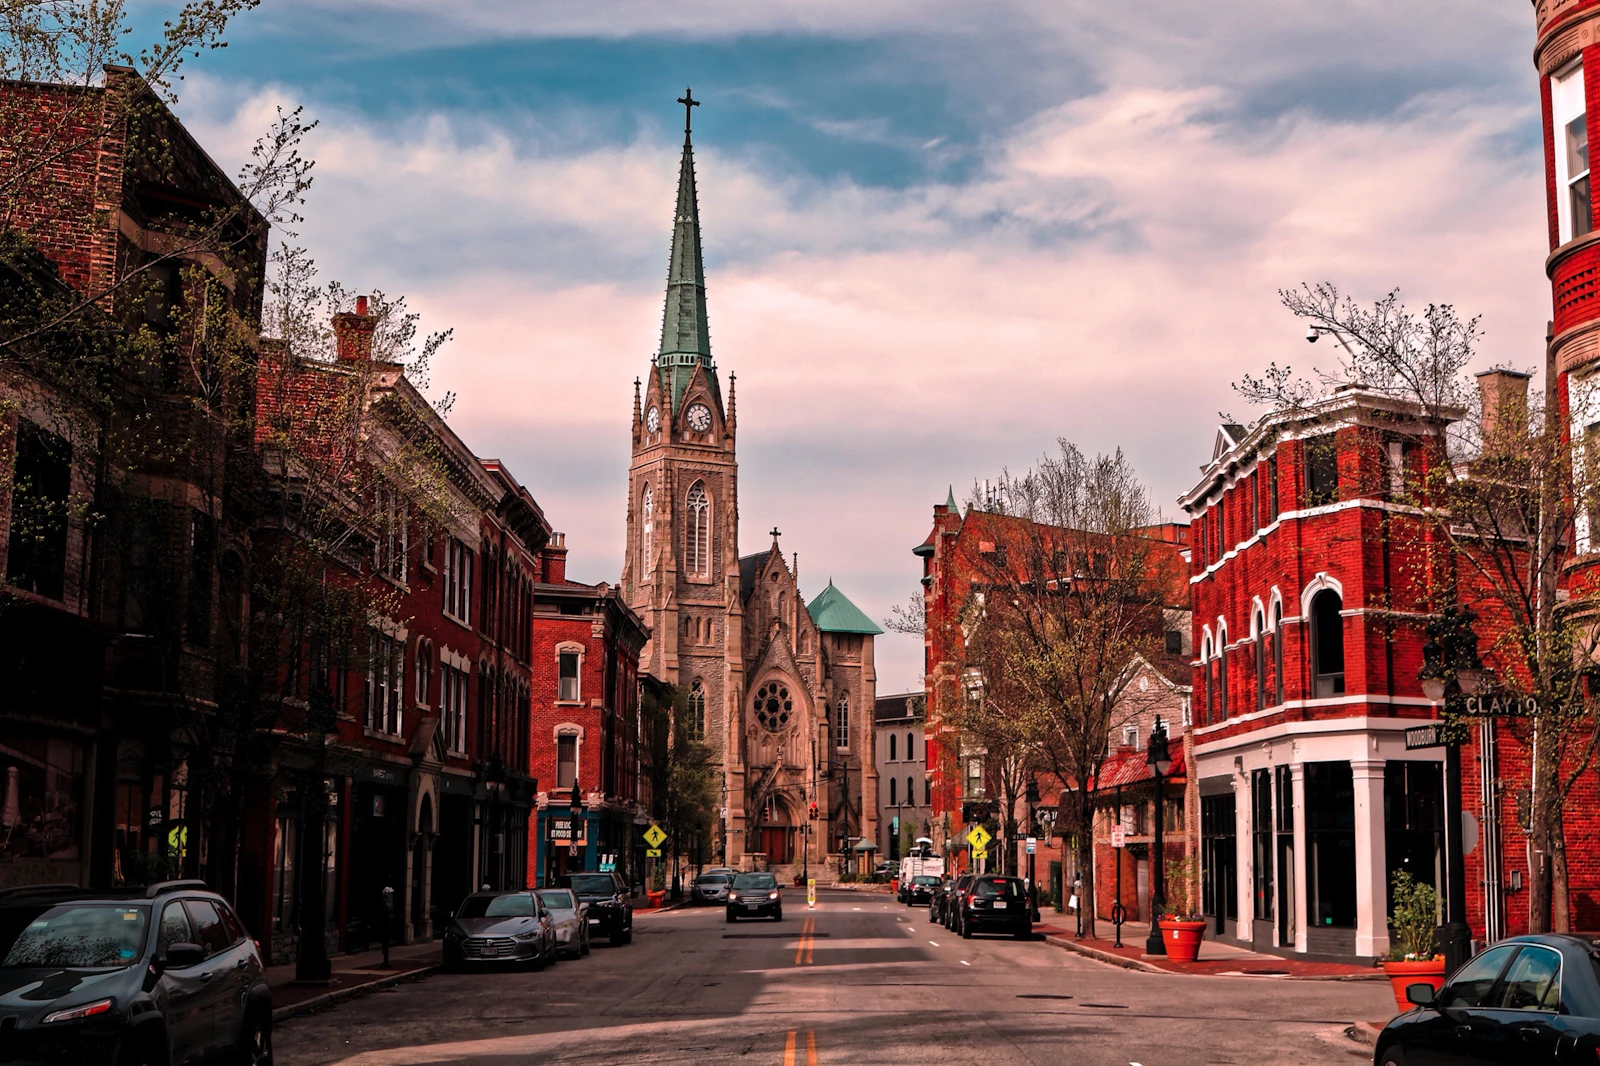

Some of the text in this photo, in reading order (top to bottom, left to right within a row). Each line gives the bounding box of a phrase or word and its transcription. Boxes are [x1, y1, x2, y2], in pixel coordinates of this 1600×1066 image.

[1466, 696, 1542, 714] CLAYTO
[1407, 727, 1437, 746] WOODBURN
[556, 829, 566, 838] FOOD
